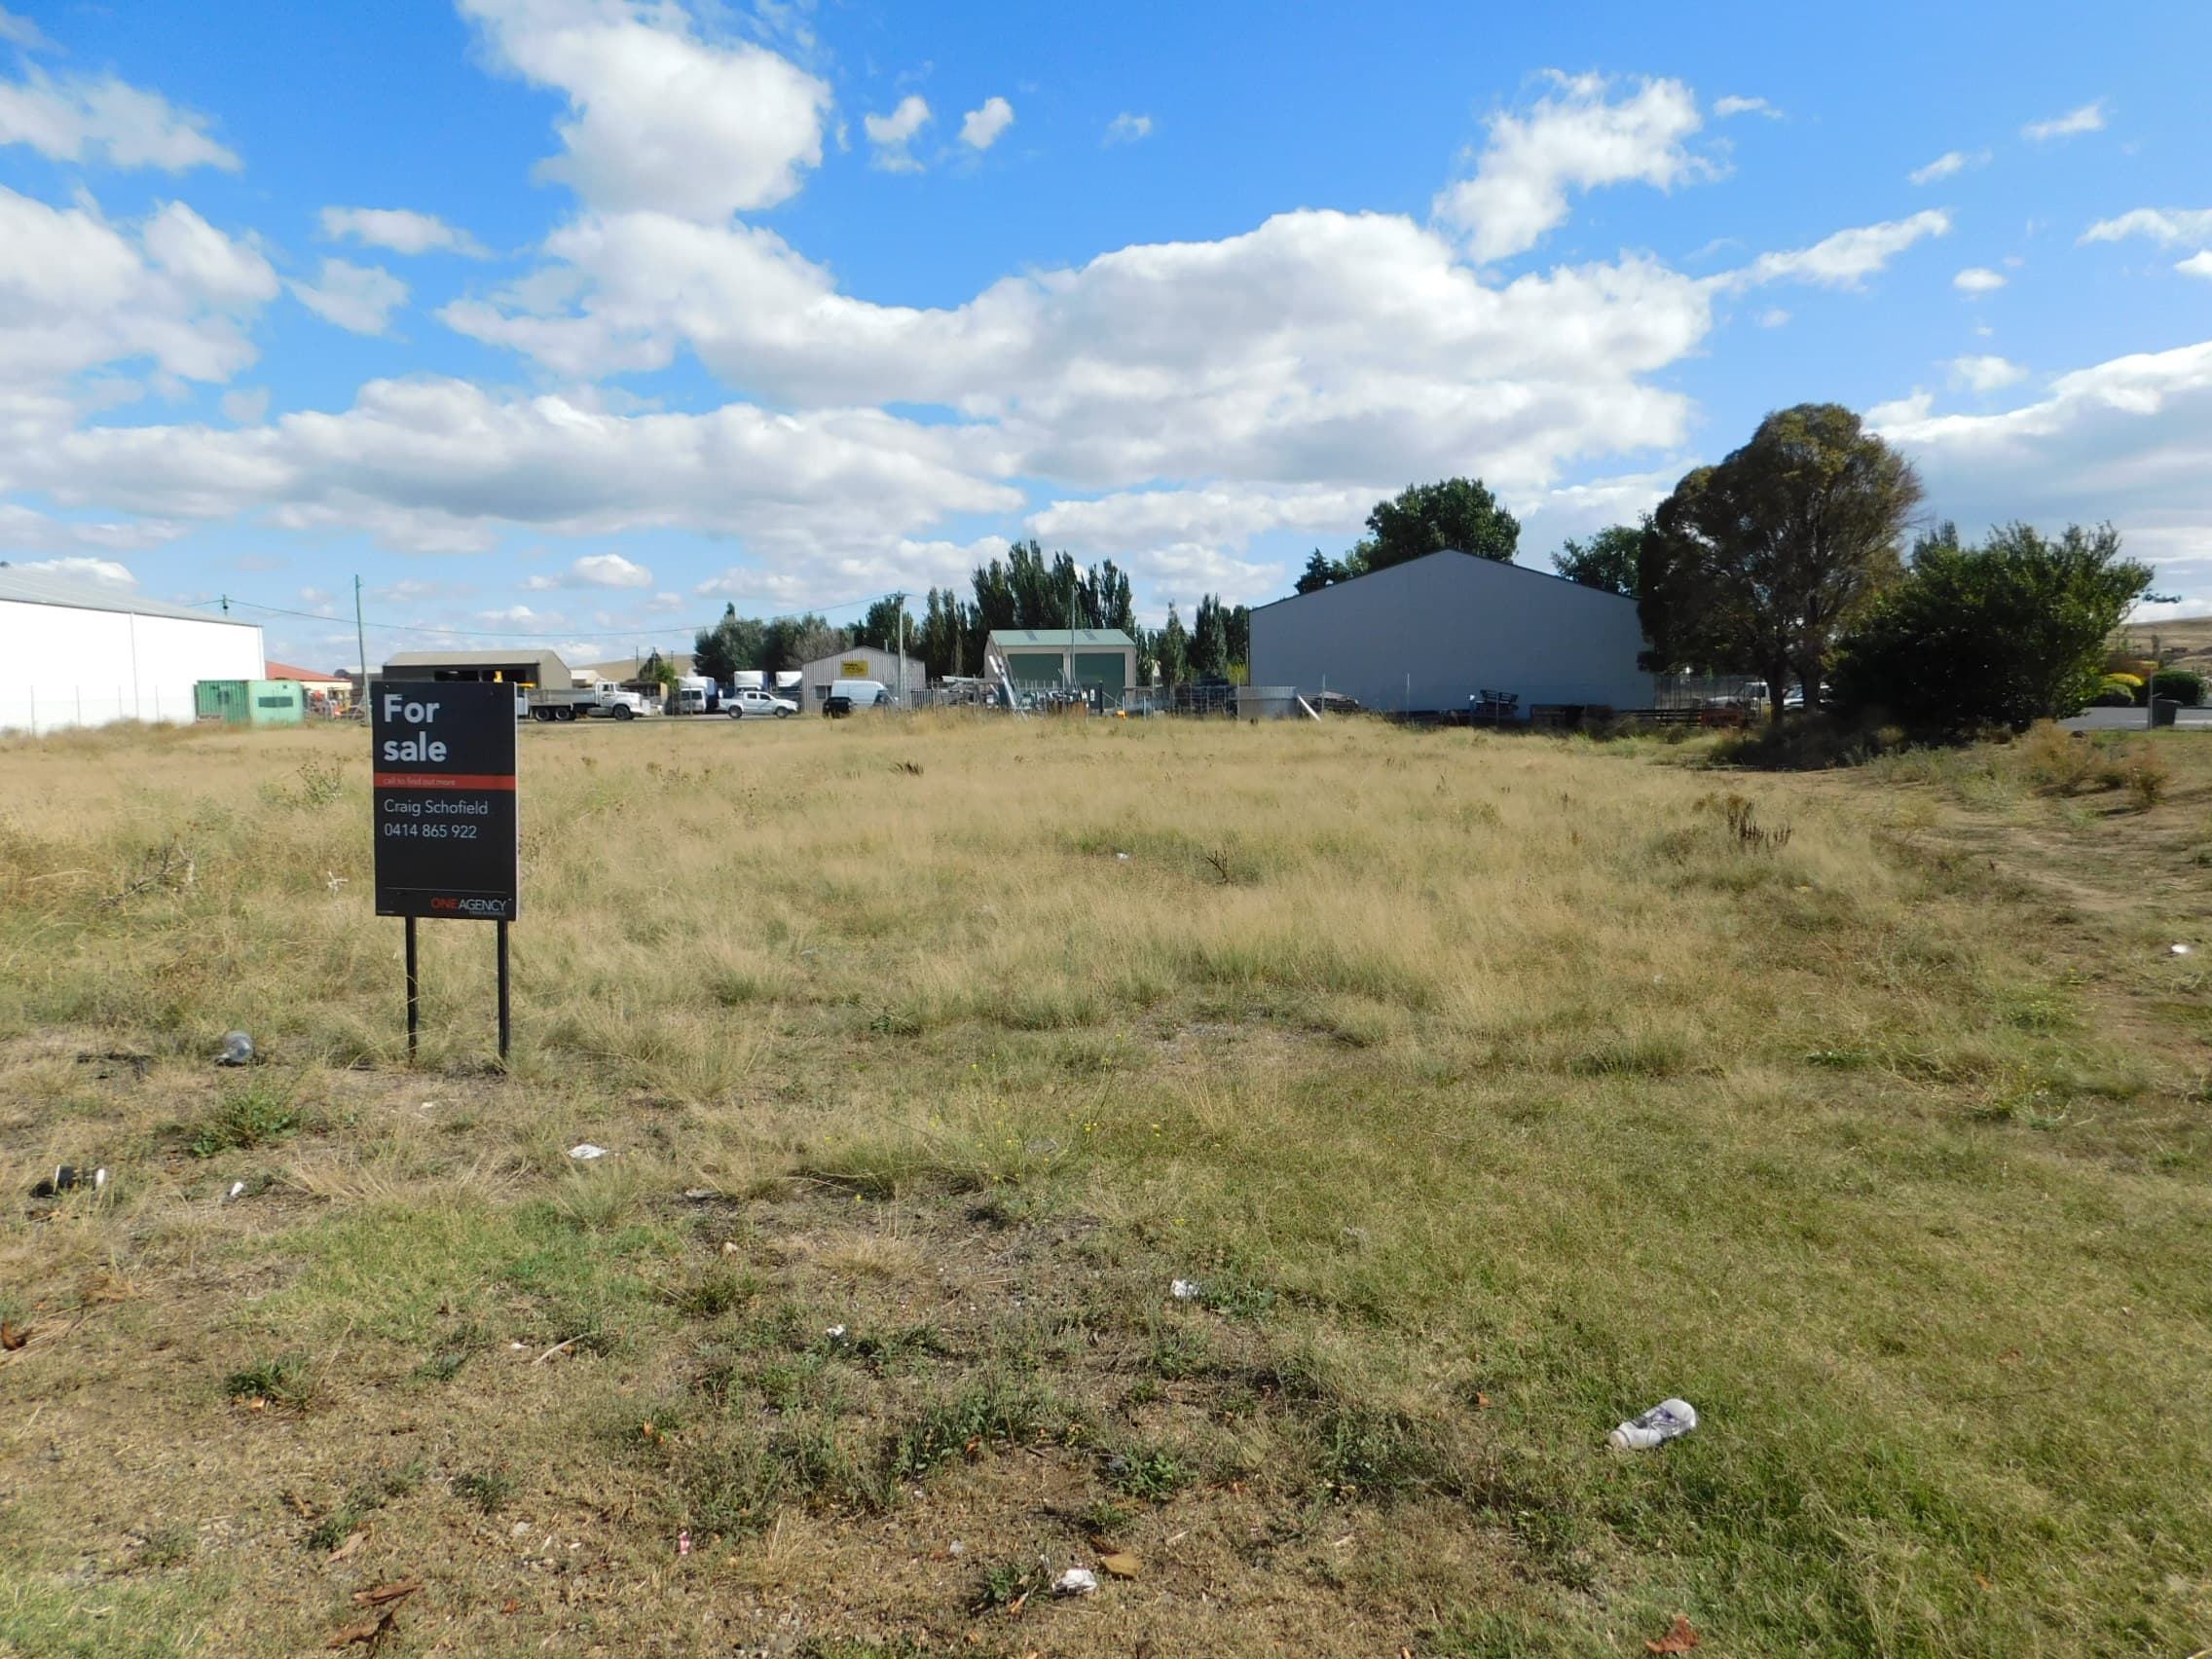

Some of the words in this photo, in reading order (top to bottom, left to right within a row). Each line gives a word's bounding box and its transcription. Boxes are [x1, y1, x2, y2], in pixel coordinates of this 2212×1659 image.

[384, 693, 440, 723] For
[384, 731, 447, 762] sale
[384, 798, 421, 816] Craig
[424, 799, 489, 815] Schofield
[384, 824, 419, 837] 0414
[422, 824, 448, 837] 865
[451, 825, 477, 838] 922
